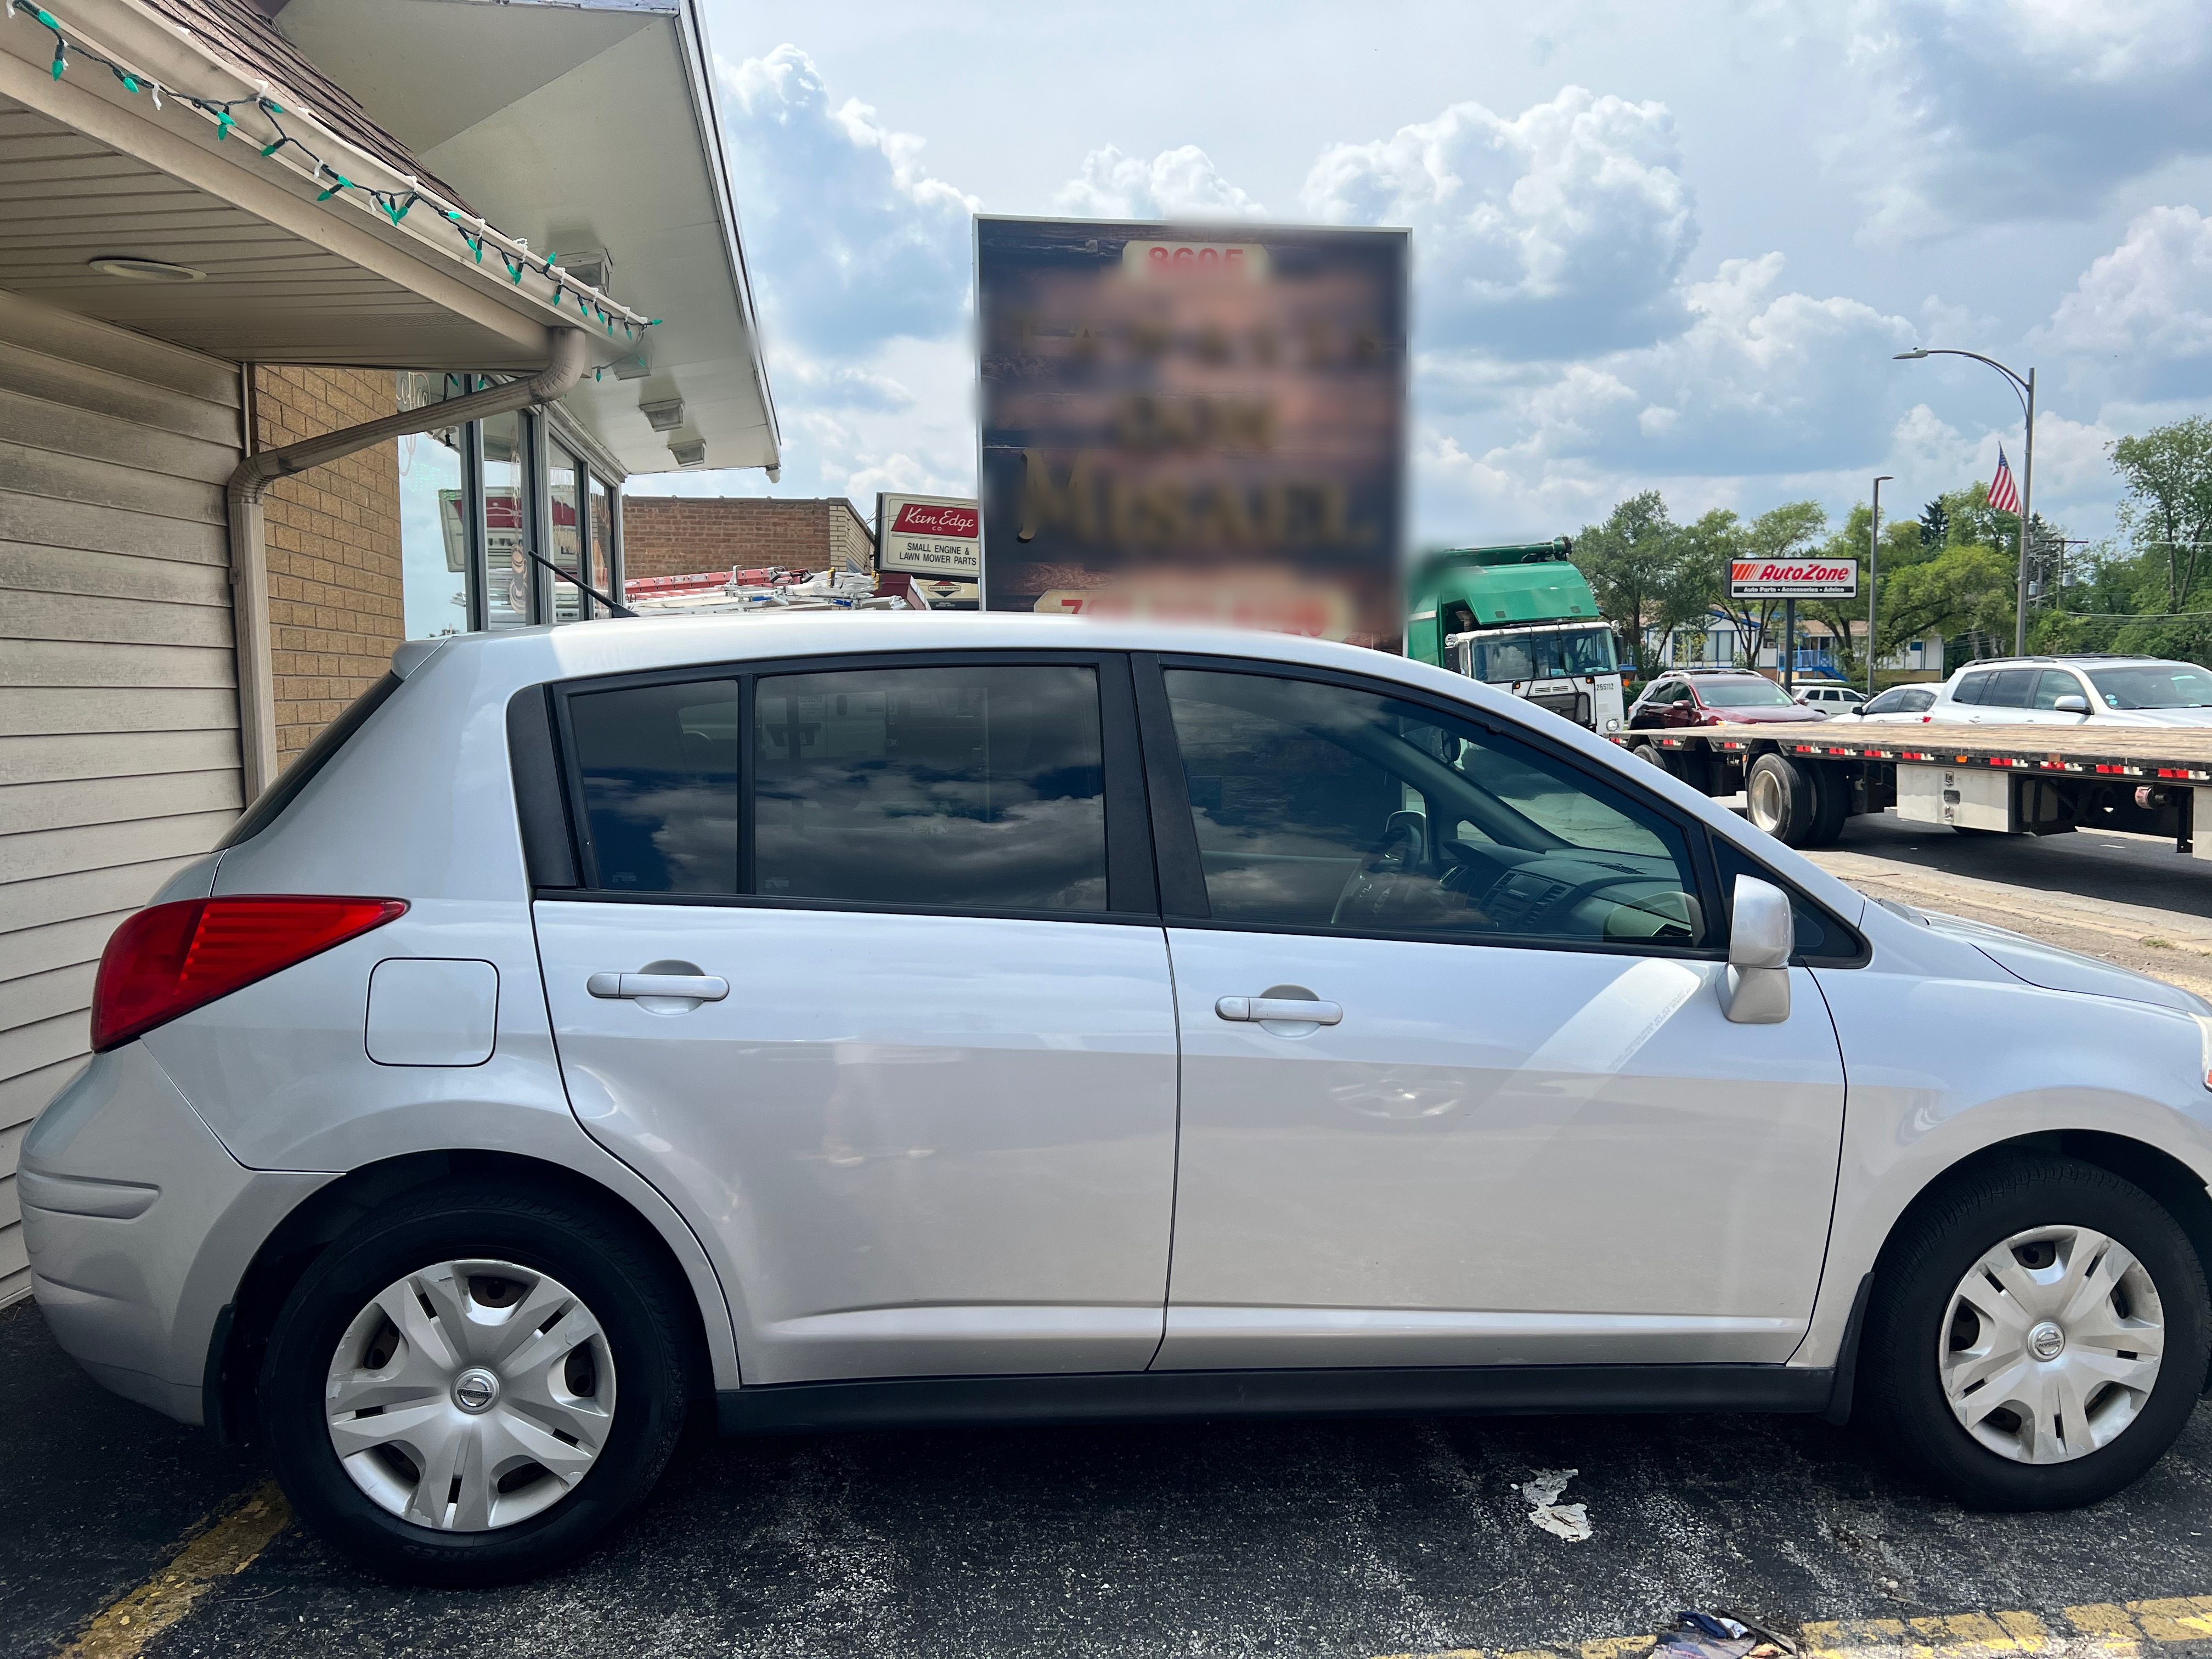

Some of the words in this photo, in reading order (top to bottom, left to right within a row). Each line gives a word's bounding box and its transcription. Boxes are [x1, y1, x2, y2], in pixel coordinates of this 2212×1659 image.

[905, 507, 937, 524] Keen
[939, 510, 974, 532] Edge
[907, 542, 931, 552] SMALL
[934, 545, 961, 555] ENGINE
[964, 547, 969, 555] &
[899, 551, 920, 561] LAWN
[923, 554, 951, 563] MOWER
[953, 556, 977, 566] PARTS
[1759, 563, 1849, 580] AutoZone
